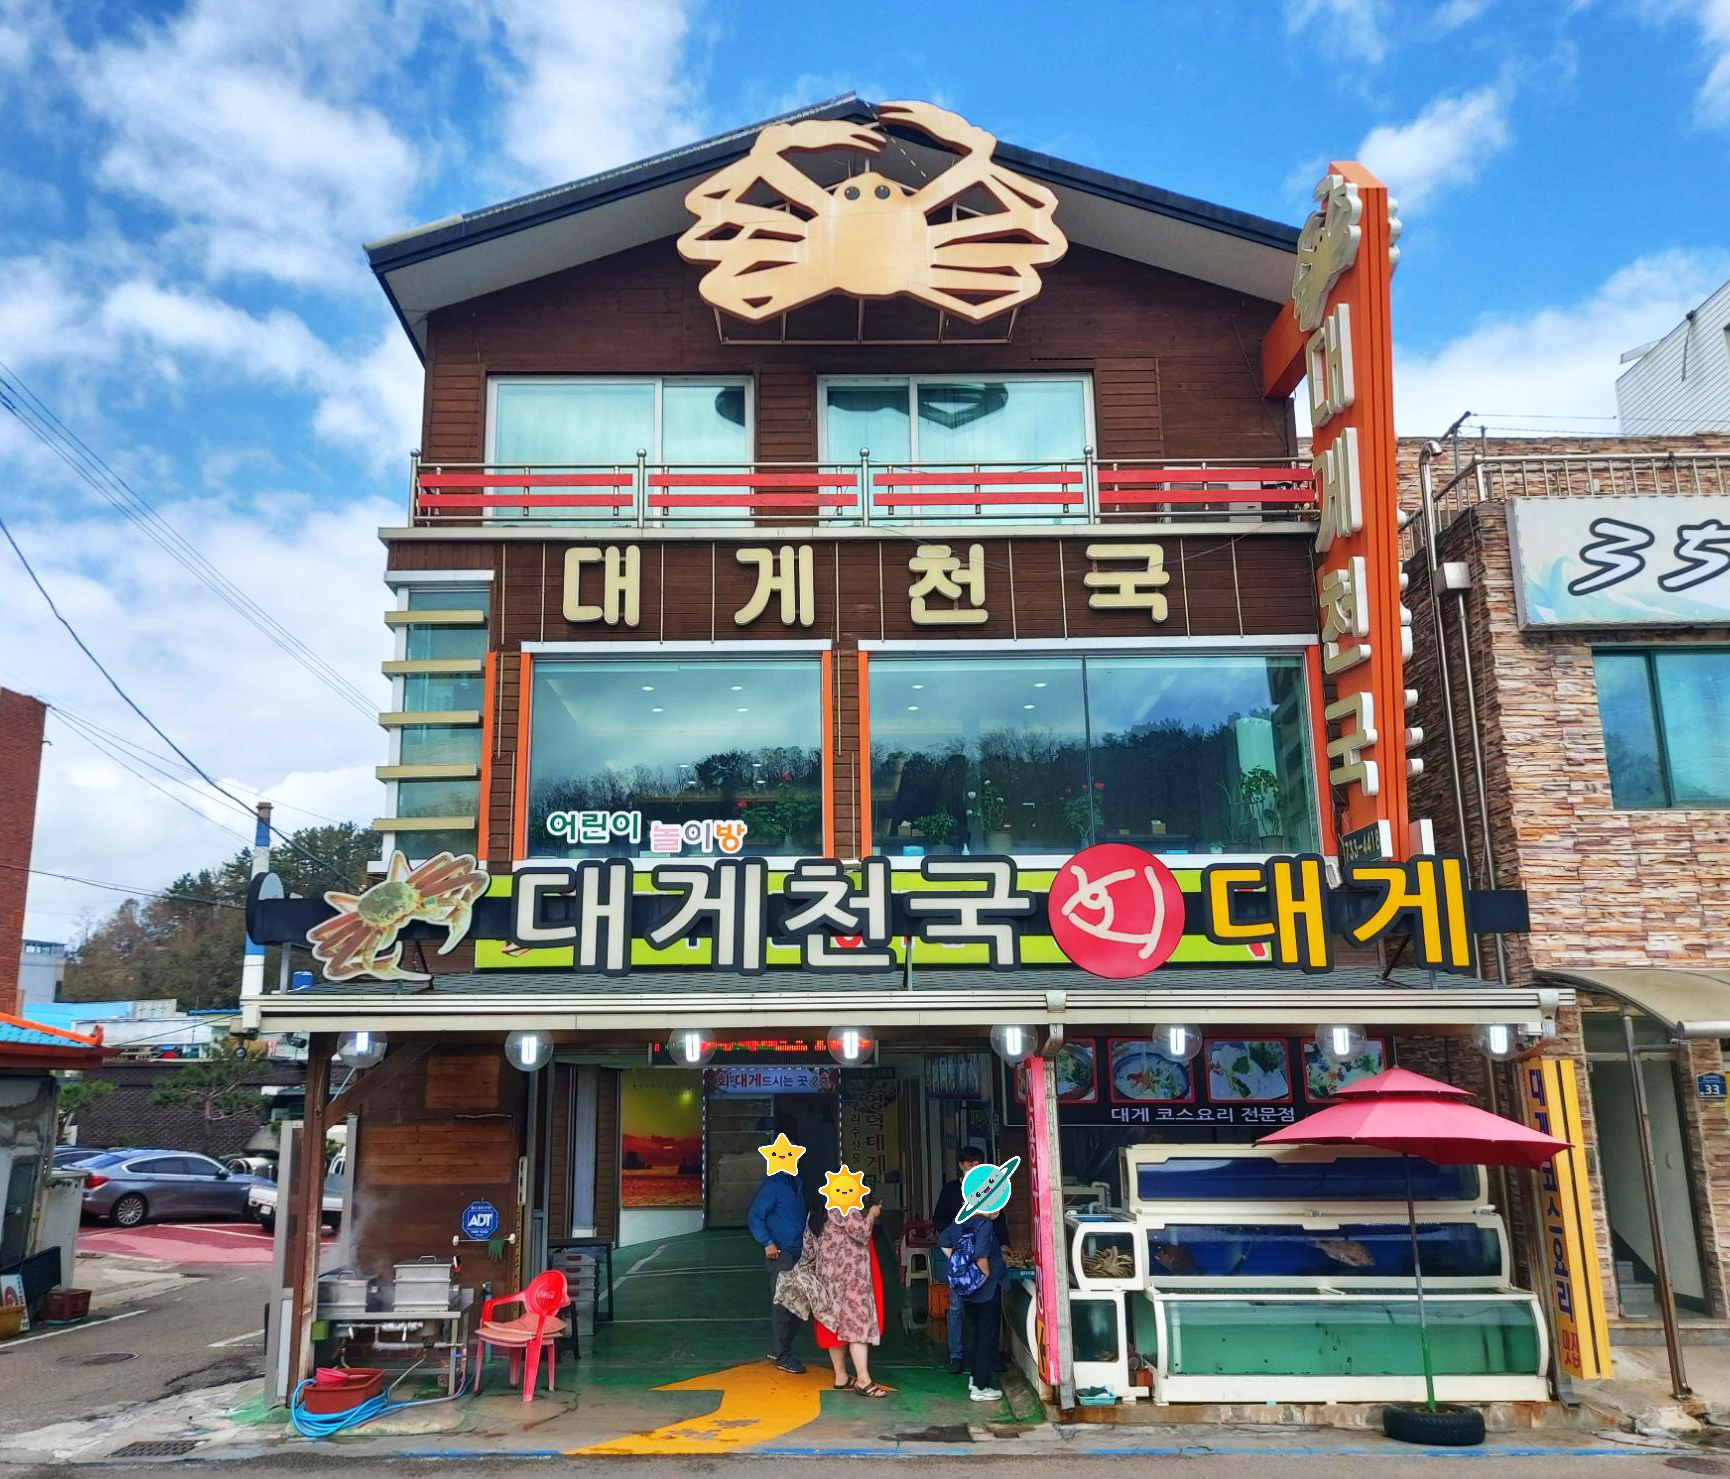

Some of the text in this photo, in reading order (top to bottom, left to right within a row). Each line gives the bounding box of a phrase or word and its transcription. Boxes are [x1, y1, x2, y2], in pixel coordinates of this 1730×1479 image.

[1306, 303, 1378, 797] 대게천국
[562, 543, 1170, 627] 대게천국
[548, 811, 748, 853] 어린이 놀이방
[514, 858, 1033, 972] 대게천국
[1209, 857, 1471, 969] 대게
[1111, 1107, 1295, 1122] 대게 코스요리 전문점
[1704, 1084, 1720, 1095] 33
[865, 1092, 886, 1176] 영덕대게
[468, 1213, 493, 1227] ADT
